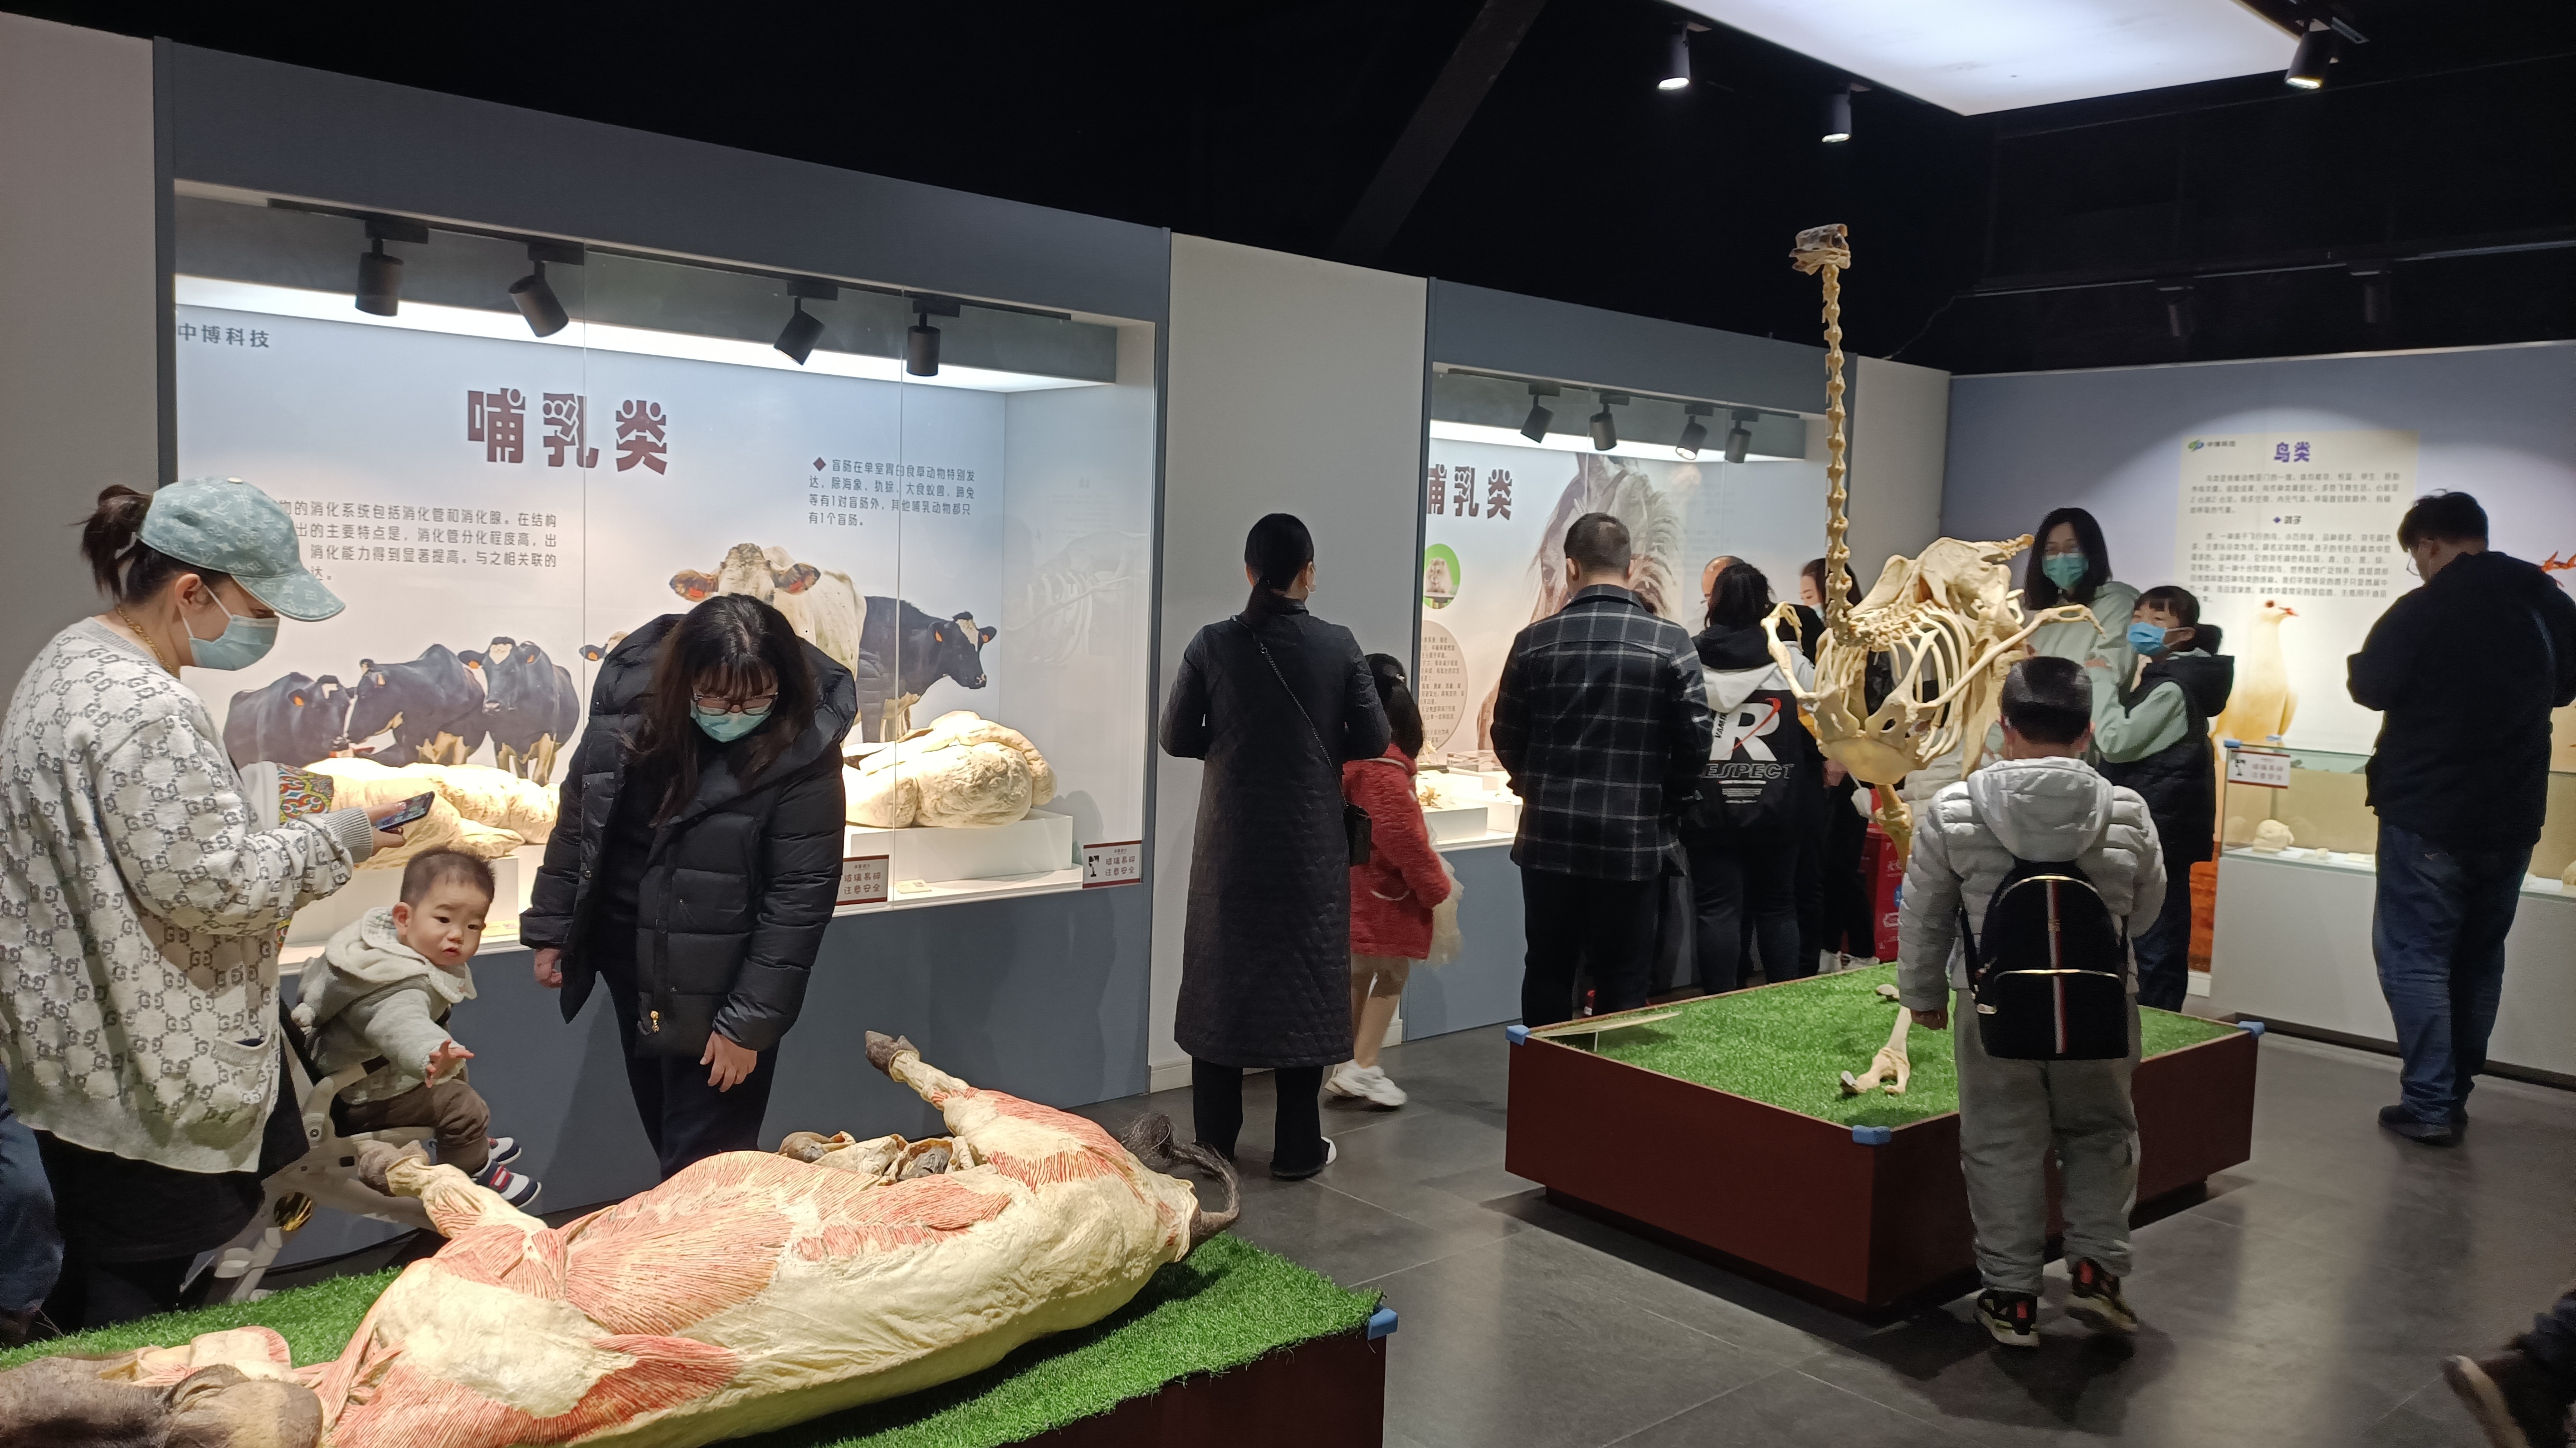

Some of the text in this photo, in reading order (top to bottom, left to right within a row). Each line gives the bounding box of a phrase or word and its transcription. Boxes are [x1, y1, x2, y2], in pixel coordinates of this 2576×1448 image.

[177, 322, 270, 348] 中博科技
[467, 387, 668, 476] 哺乳类
[2273, 441, 2311, 463] 鸟类
[1105, 866, 1135, 876] 注意安全
[843, 883, 881, 894] 注意安全
